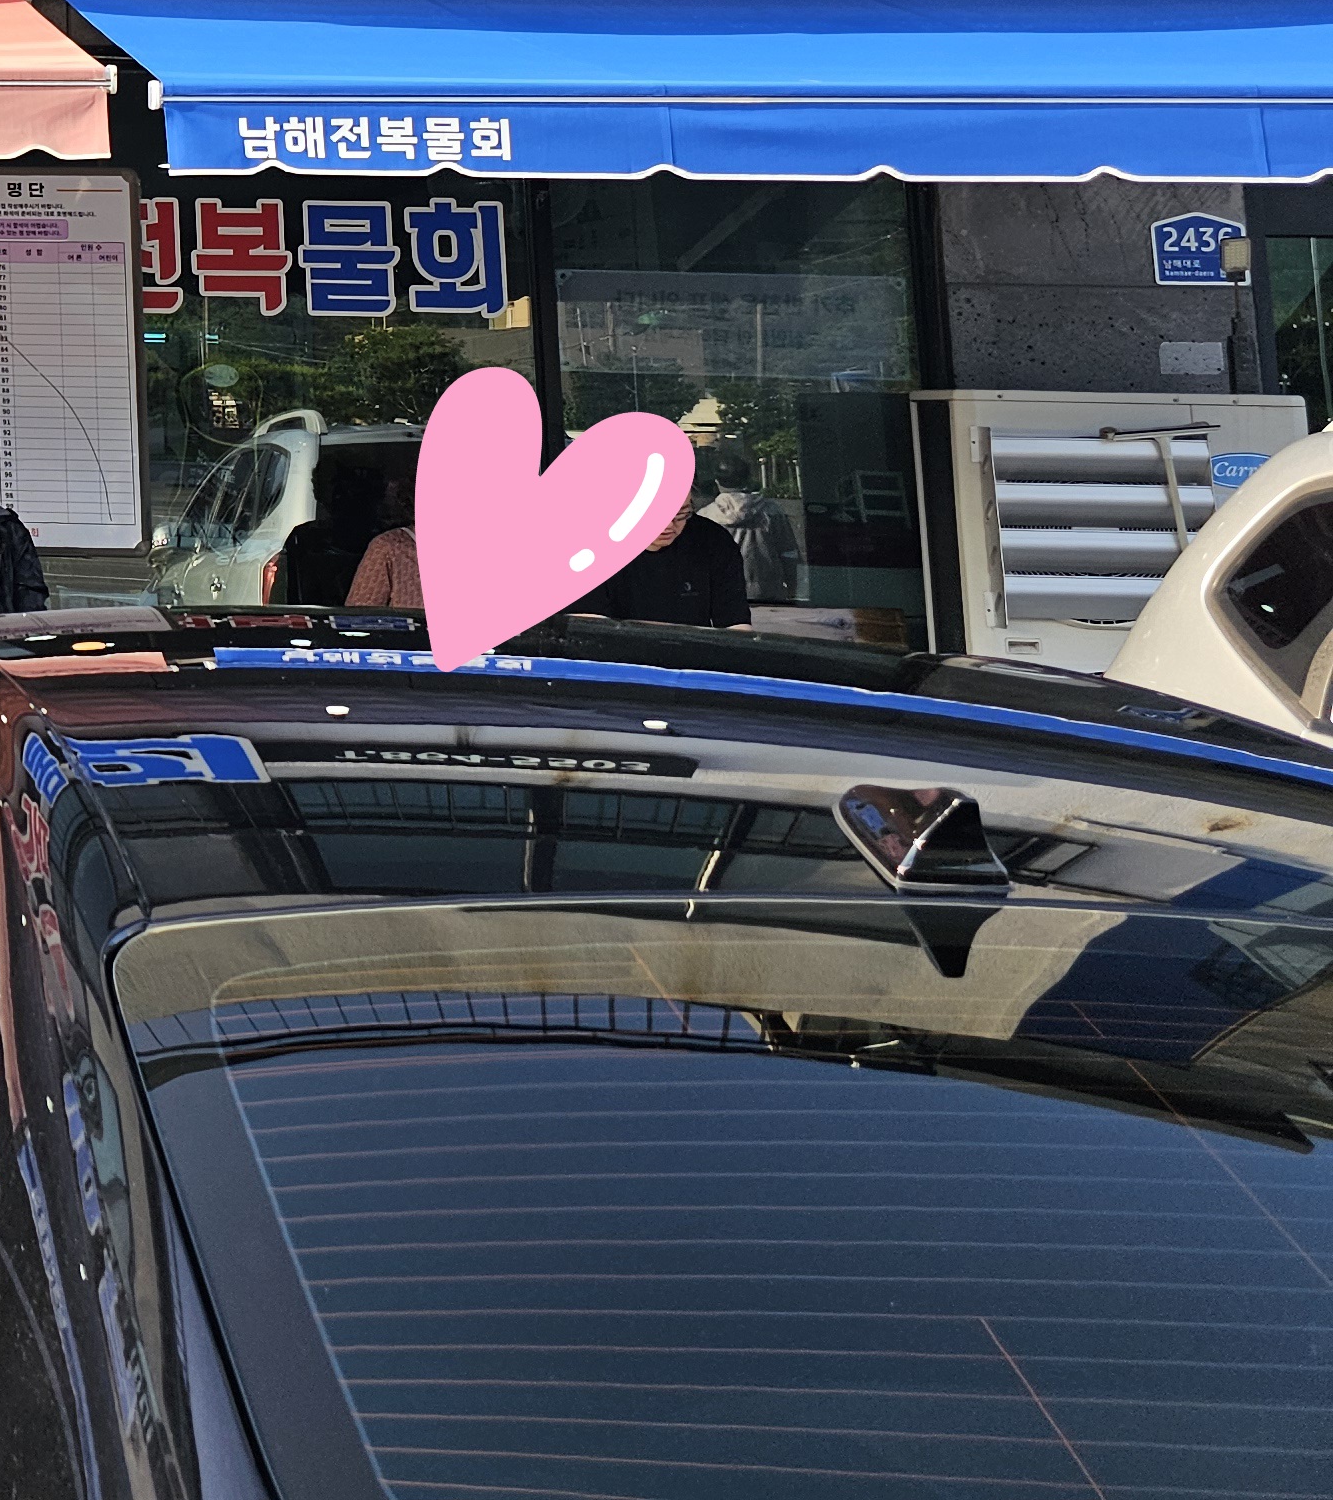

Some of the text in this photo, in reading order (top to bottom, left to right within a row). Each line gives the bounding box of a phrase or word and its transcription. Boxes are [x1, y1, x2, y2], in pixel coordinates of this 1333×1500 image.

[237, 115, 512, 162] 남해전복물회
[7, 183, 45, 198] 명단
[1163, 259, 1201, 269] 남해대로
[1213, 461, 1263, 477] Carr
